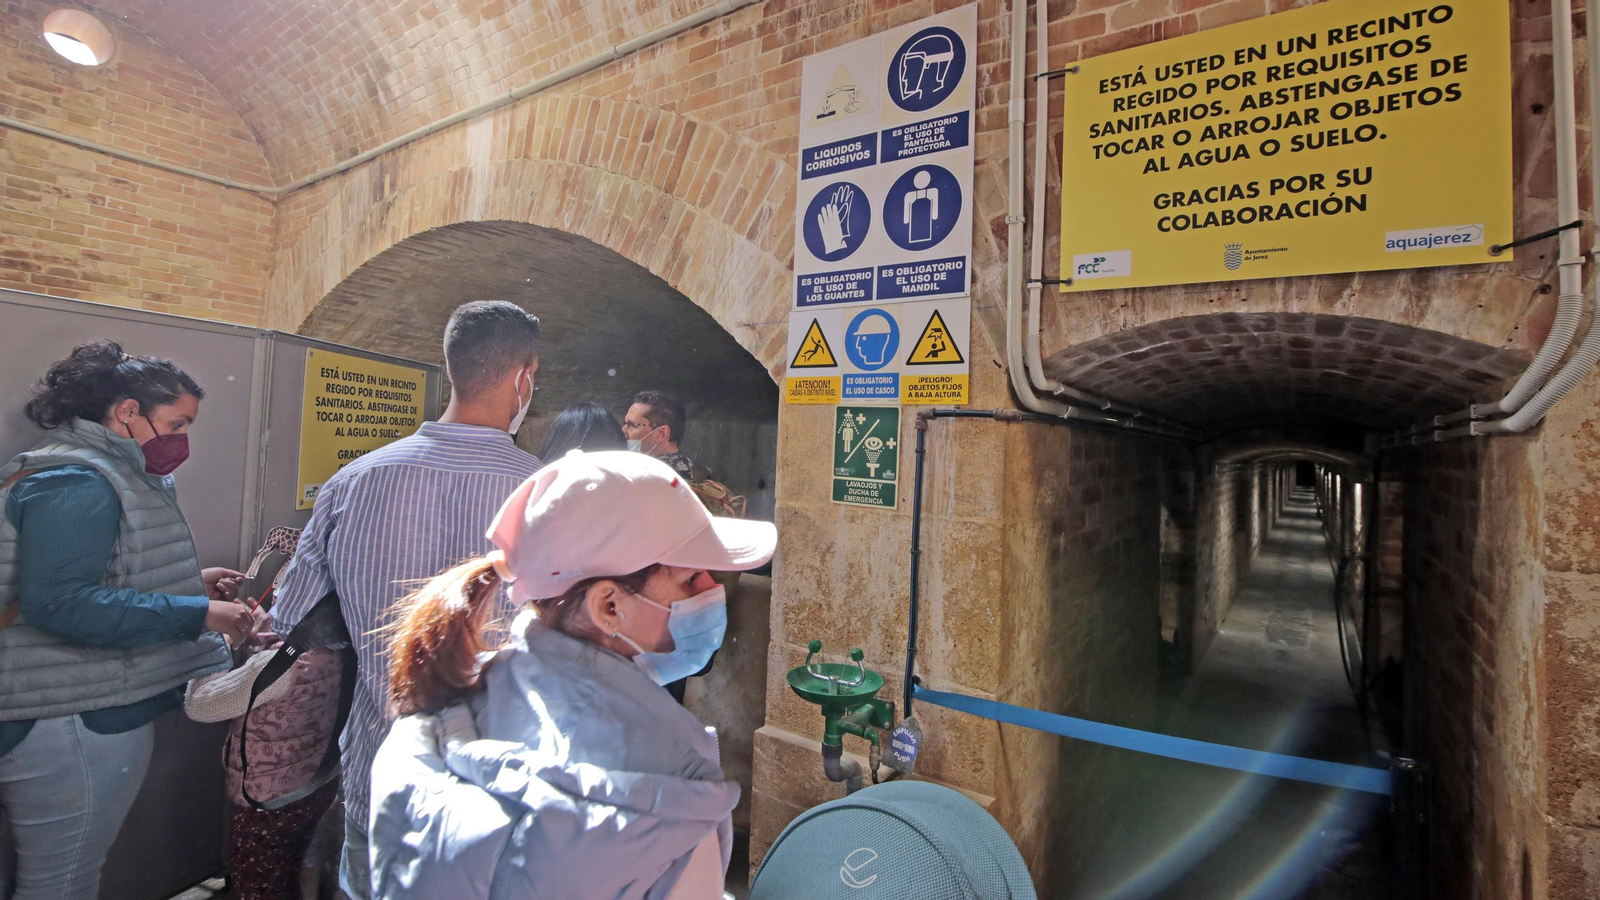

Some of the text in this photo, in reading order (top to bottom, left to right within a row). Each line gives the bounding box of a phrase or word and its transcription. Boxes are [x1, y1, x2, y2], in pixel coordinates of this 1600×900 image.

[1100, 4, 1453, 94] ESTÁ USTED EN UN RECINTO
[1113, 35, 1432, 112] REGIDO POR REQUISITOS
[1089, 55, 1467, 139] SANITARIOS. ABSTENGASE DE
[904, 117, 958, 135] OBLIGATORIO
[1092, 83, 1462, 159] TOCAR O ARROJAR OBJETOS
[904, 134, 944, 148] PANTALLA
[916, 131, 932, 139] USO
[814, 142, 861, 160] LIQUIDOS
[898, 140, 950, 157] PROTECTORA
[1143, 124, 1387, 174] AL AGUA O SUELO.
[806, 150, 870, 172] CORROSIVOS
[1154, 167, 1372, 210] GRACIAS POR SU
[1158, 192, 1367, 232] COLABORACIÓN
[1386, 230, 1471, 250] aquajerez
[1245, 247, 1288, 255] Ayuntamiento
[882, 261, 963, 277] ES OBLIGATORIO
[1078, 263, 1100, 274] FCC
[802, 272, 871, 286] ES OBLIGATORIO
[896, 277, 908, 285] EL
[910, 274, 928, 283] USO
[814, 285, 824, 293] EL
[826, 283, 844, 292] USO
[902, 282, 939, 293] MANDIL
[806, 290, 864, 302] LOS GUANTES
[321, 366, 416, 391] ESTÁ USTED EN UN RECINTO
[918, 376, 952, 384] ¡PELIGRO!
[326, 383, 411, 402] REGIDO POR REQUISITOS
[316, 396, 365, 410] SANITARIOS.
[367, 403, 408, 414] ABSTENGASE
[317, 411, 415, 426] TOCAR O ARROJAR OBJETOS
[335, 427, 344, 436] AL
[347, 428, 369, 437] AGUA
[372, 429, 377, 437] O
[846, 481, 877, 489] LAVAOJOS
[849, 488, 869, 496] DUCHA
[844, 495, 883, 504] EMERGENCIA
[893, 728, 916, 744] EMPUJAR
[894, 752, 910, 762] PUSH
